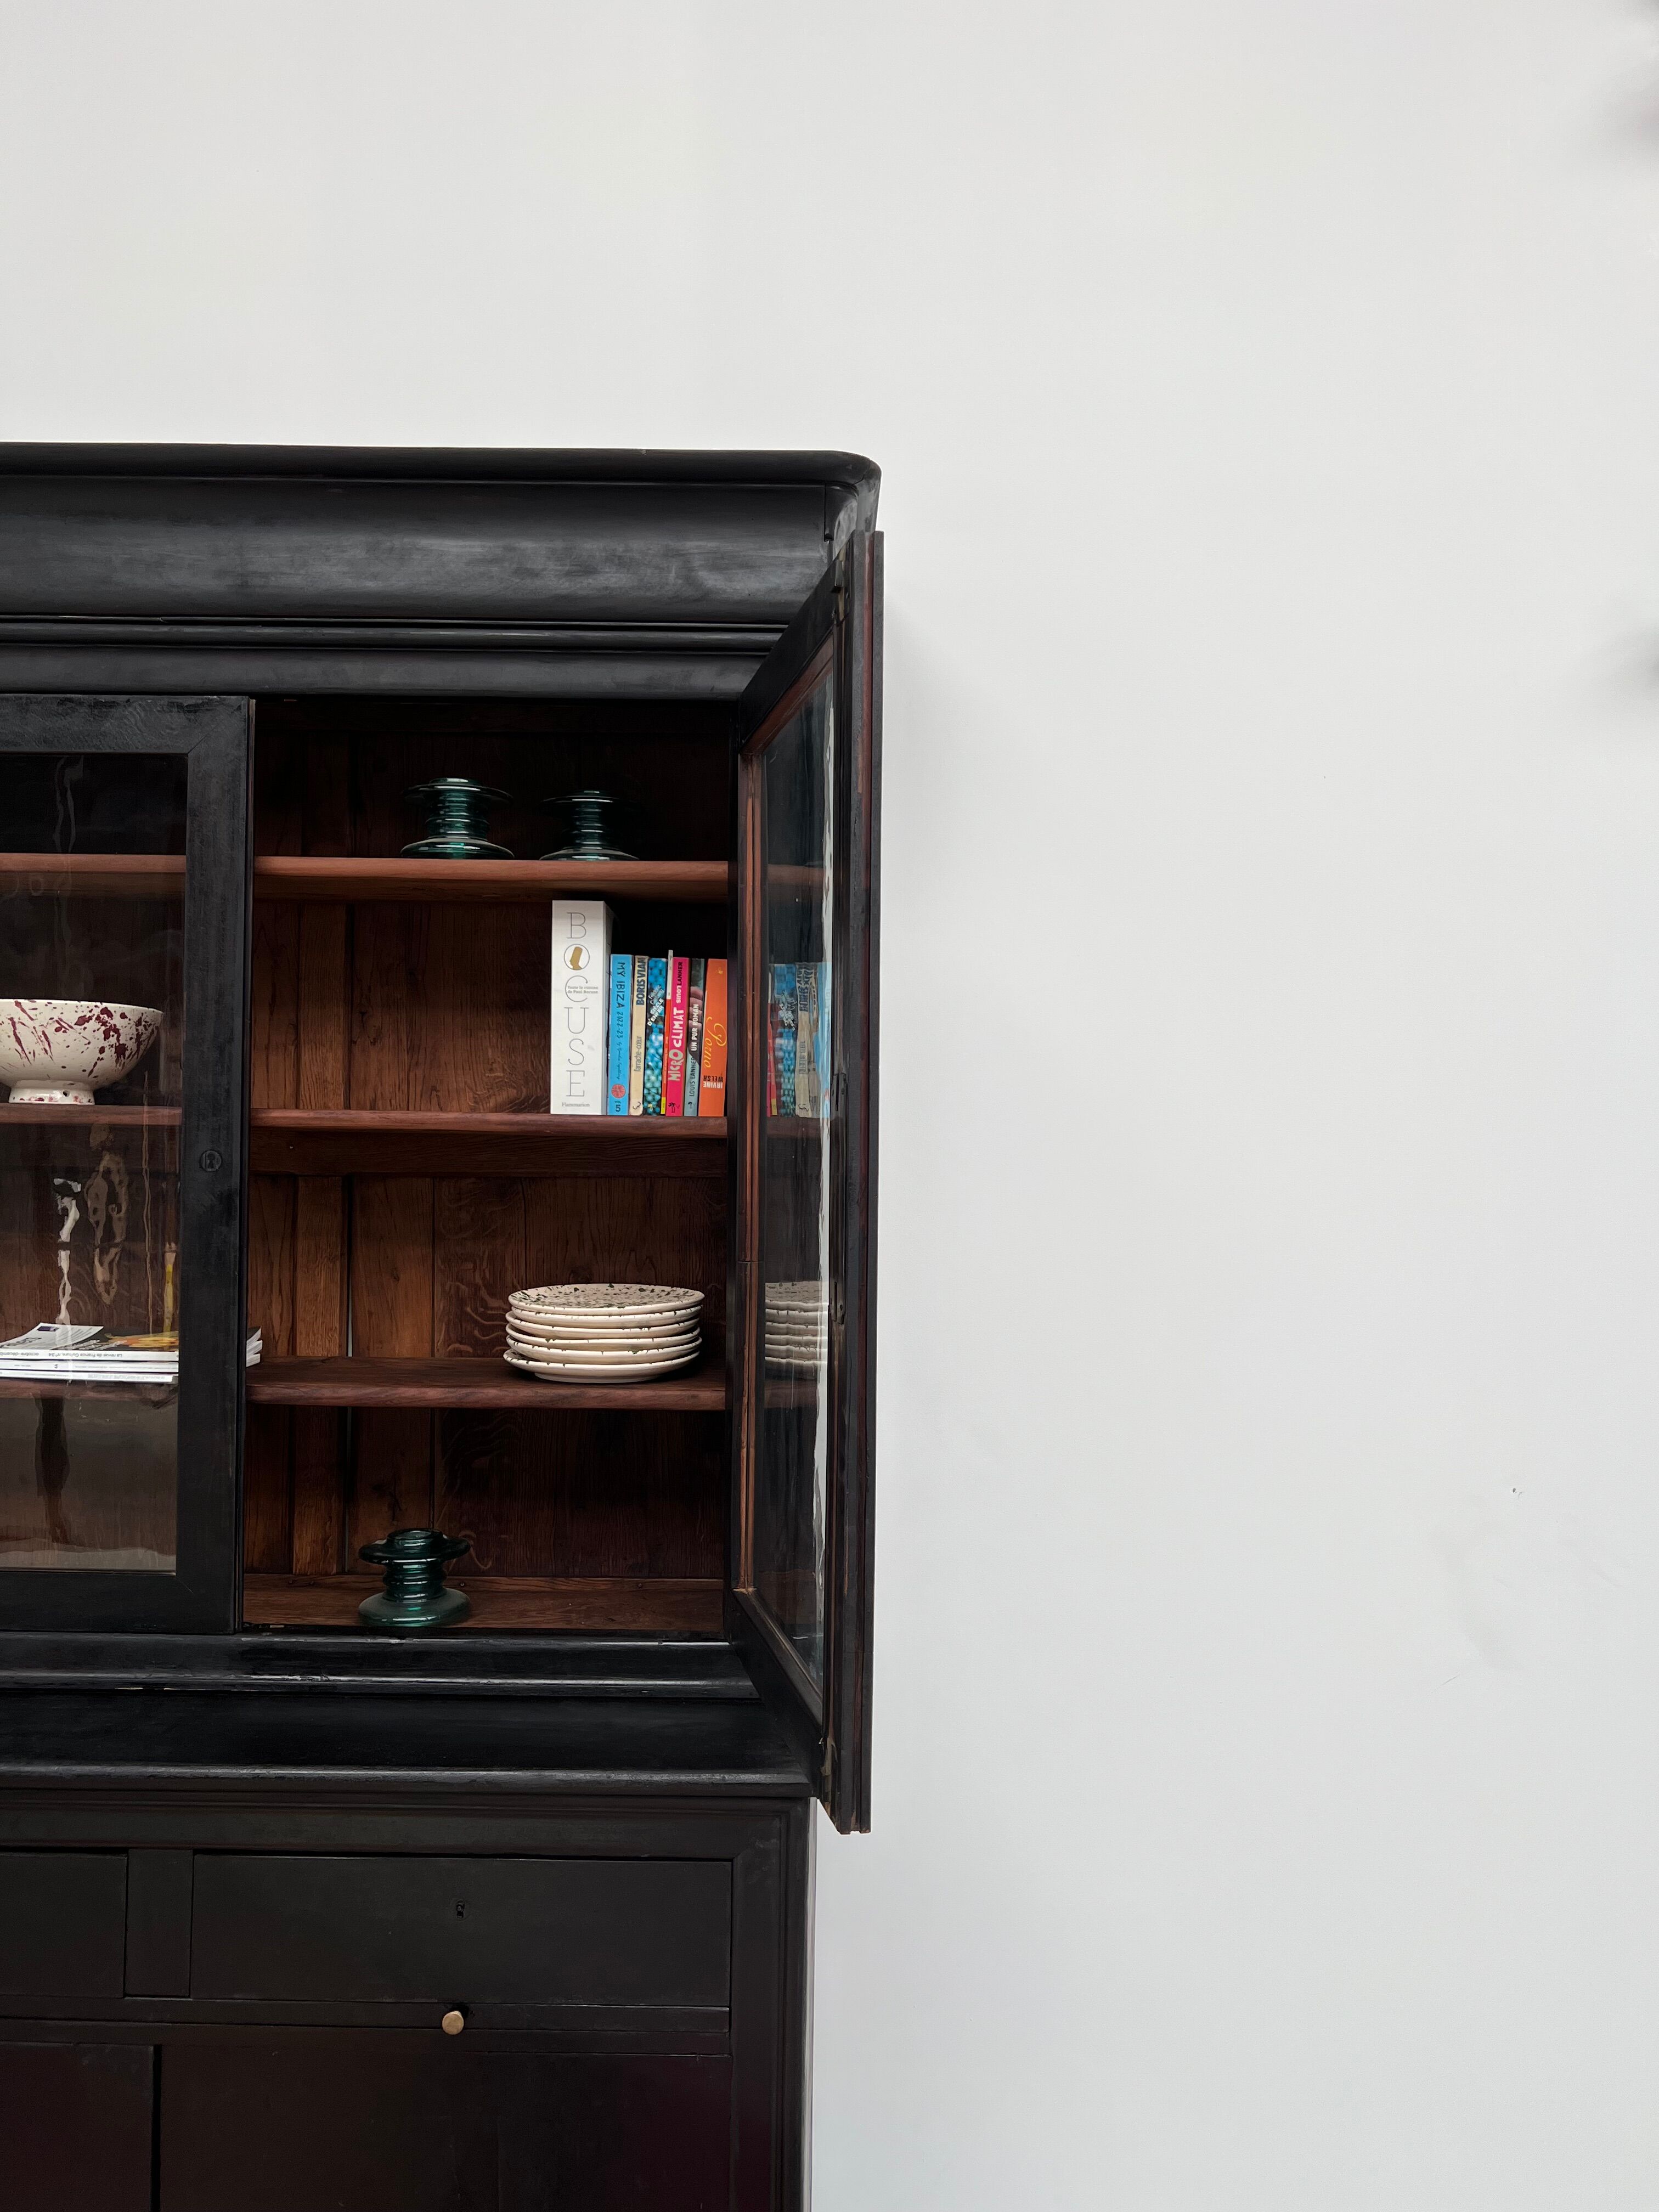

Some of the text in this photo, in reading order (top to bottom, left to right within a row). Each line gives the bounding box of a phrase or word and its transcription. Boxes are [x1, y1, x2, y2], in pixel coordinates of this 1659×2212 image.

[617, 961, 626, 978] MY
[636, 957, 648, 1006] BORIS VIAN
[563, 912, 590, 1097] BOCUSE
[616, 981, 625, 1009] IBIZA
[616, 1011, 624, 1040] 2022-23
[691, 1042, 697, 1051] UN
[702, 1017, 727, 1068] Porno
[703, 1081, 723, 1089] IRVINE
